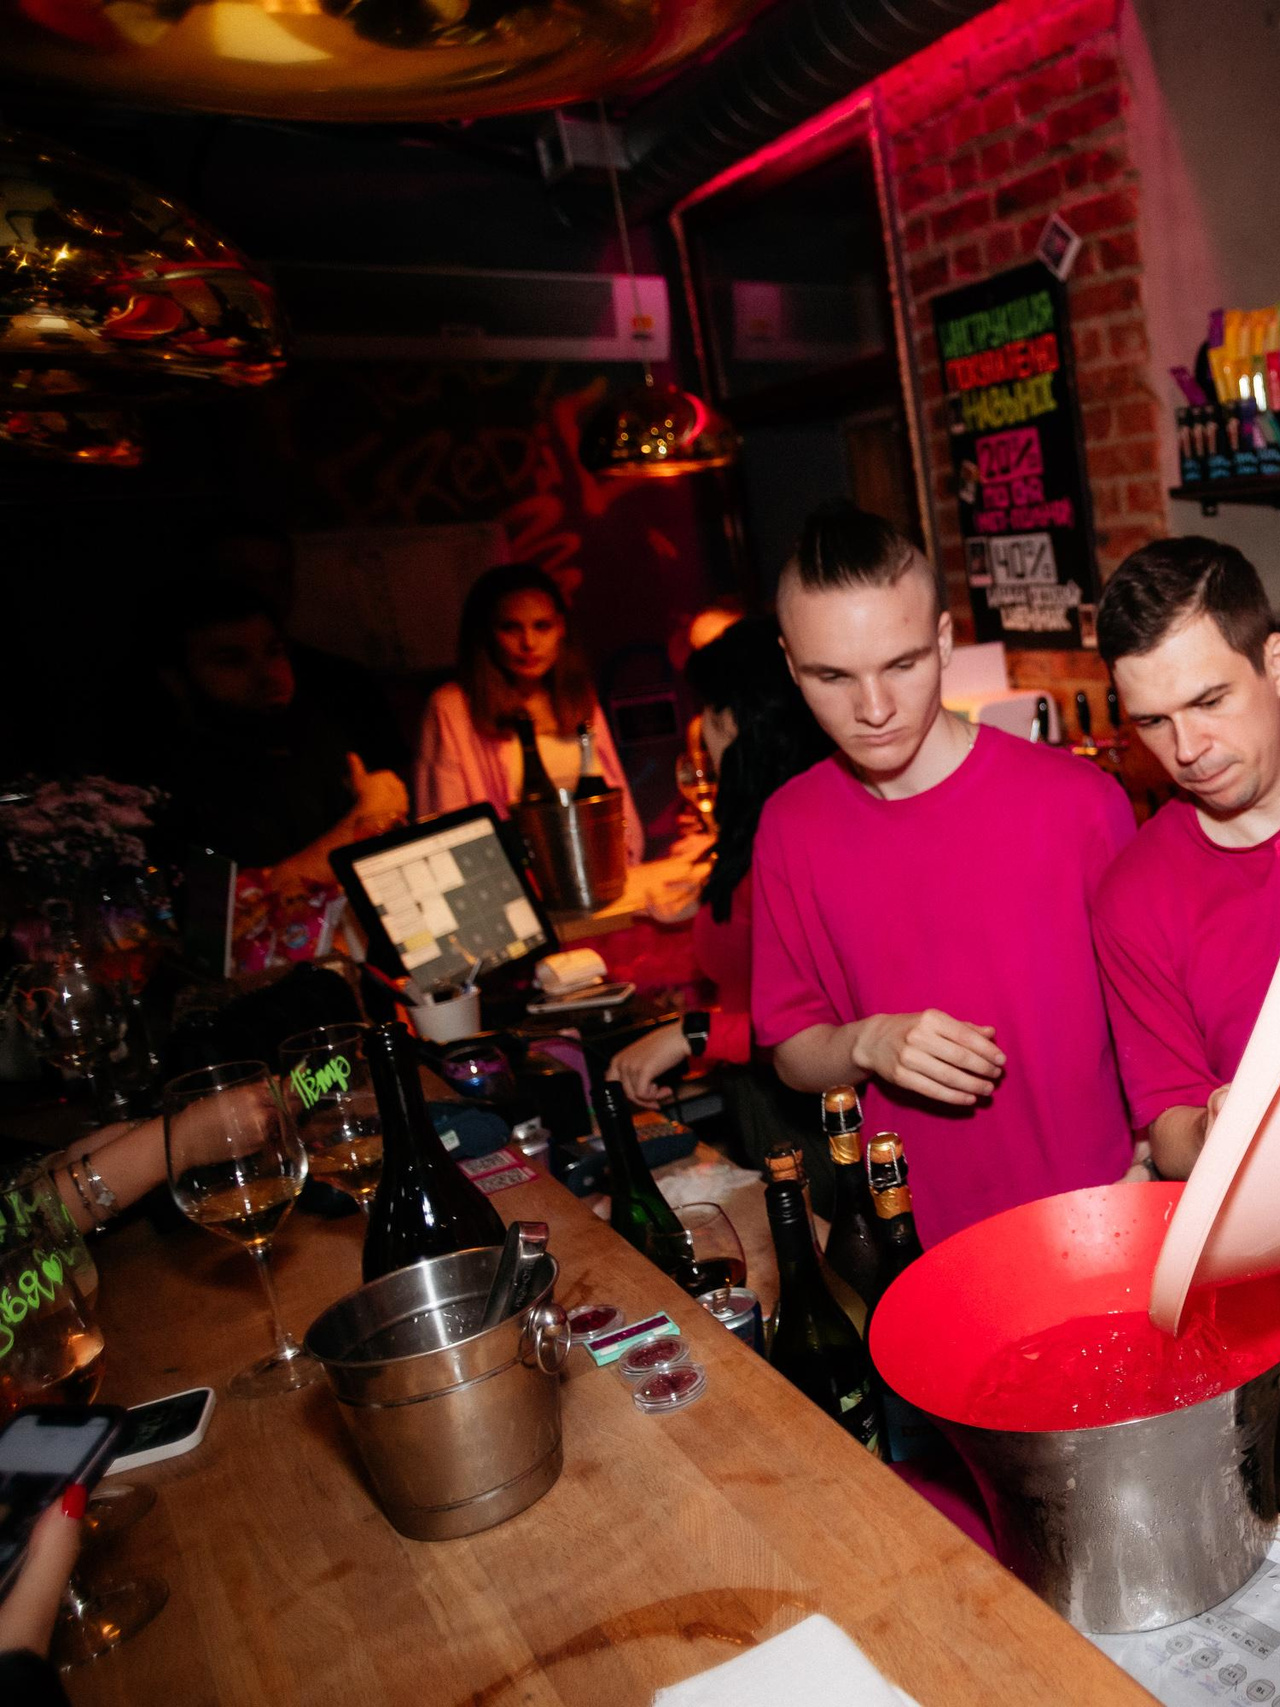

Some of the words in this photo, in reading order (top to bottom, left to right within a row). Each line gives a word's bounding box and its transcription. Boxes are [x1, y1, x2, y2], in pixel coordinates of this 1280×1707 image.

[981, 438, 1038, 478] 20%
[992, 536, 1053, 582] 40%
[1258, 1645, 1269, 1655] 30
[1227, 1670, 1237, 1679] 17
